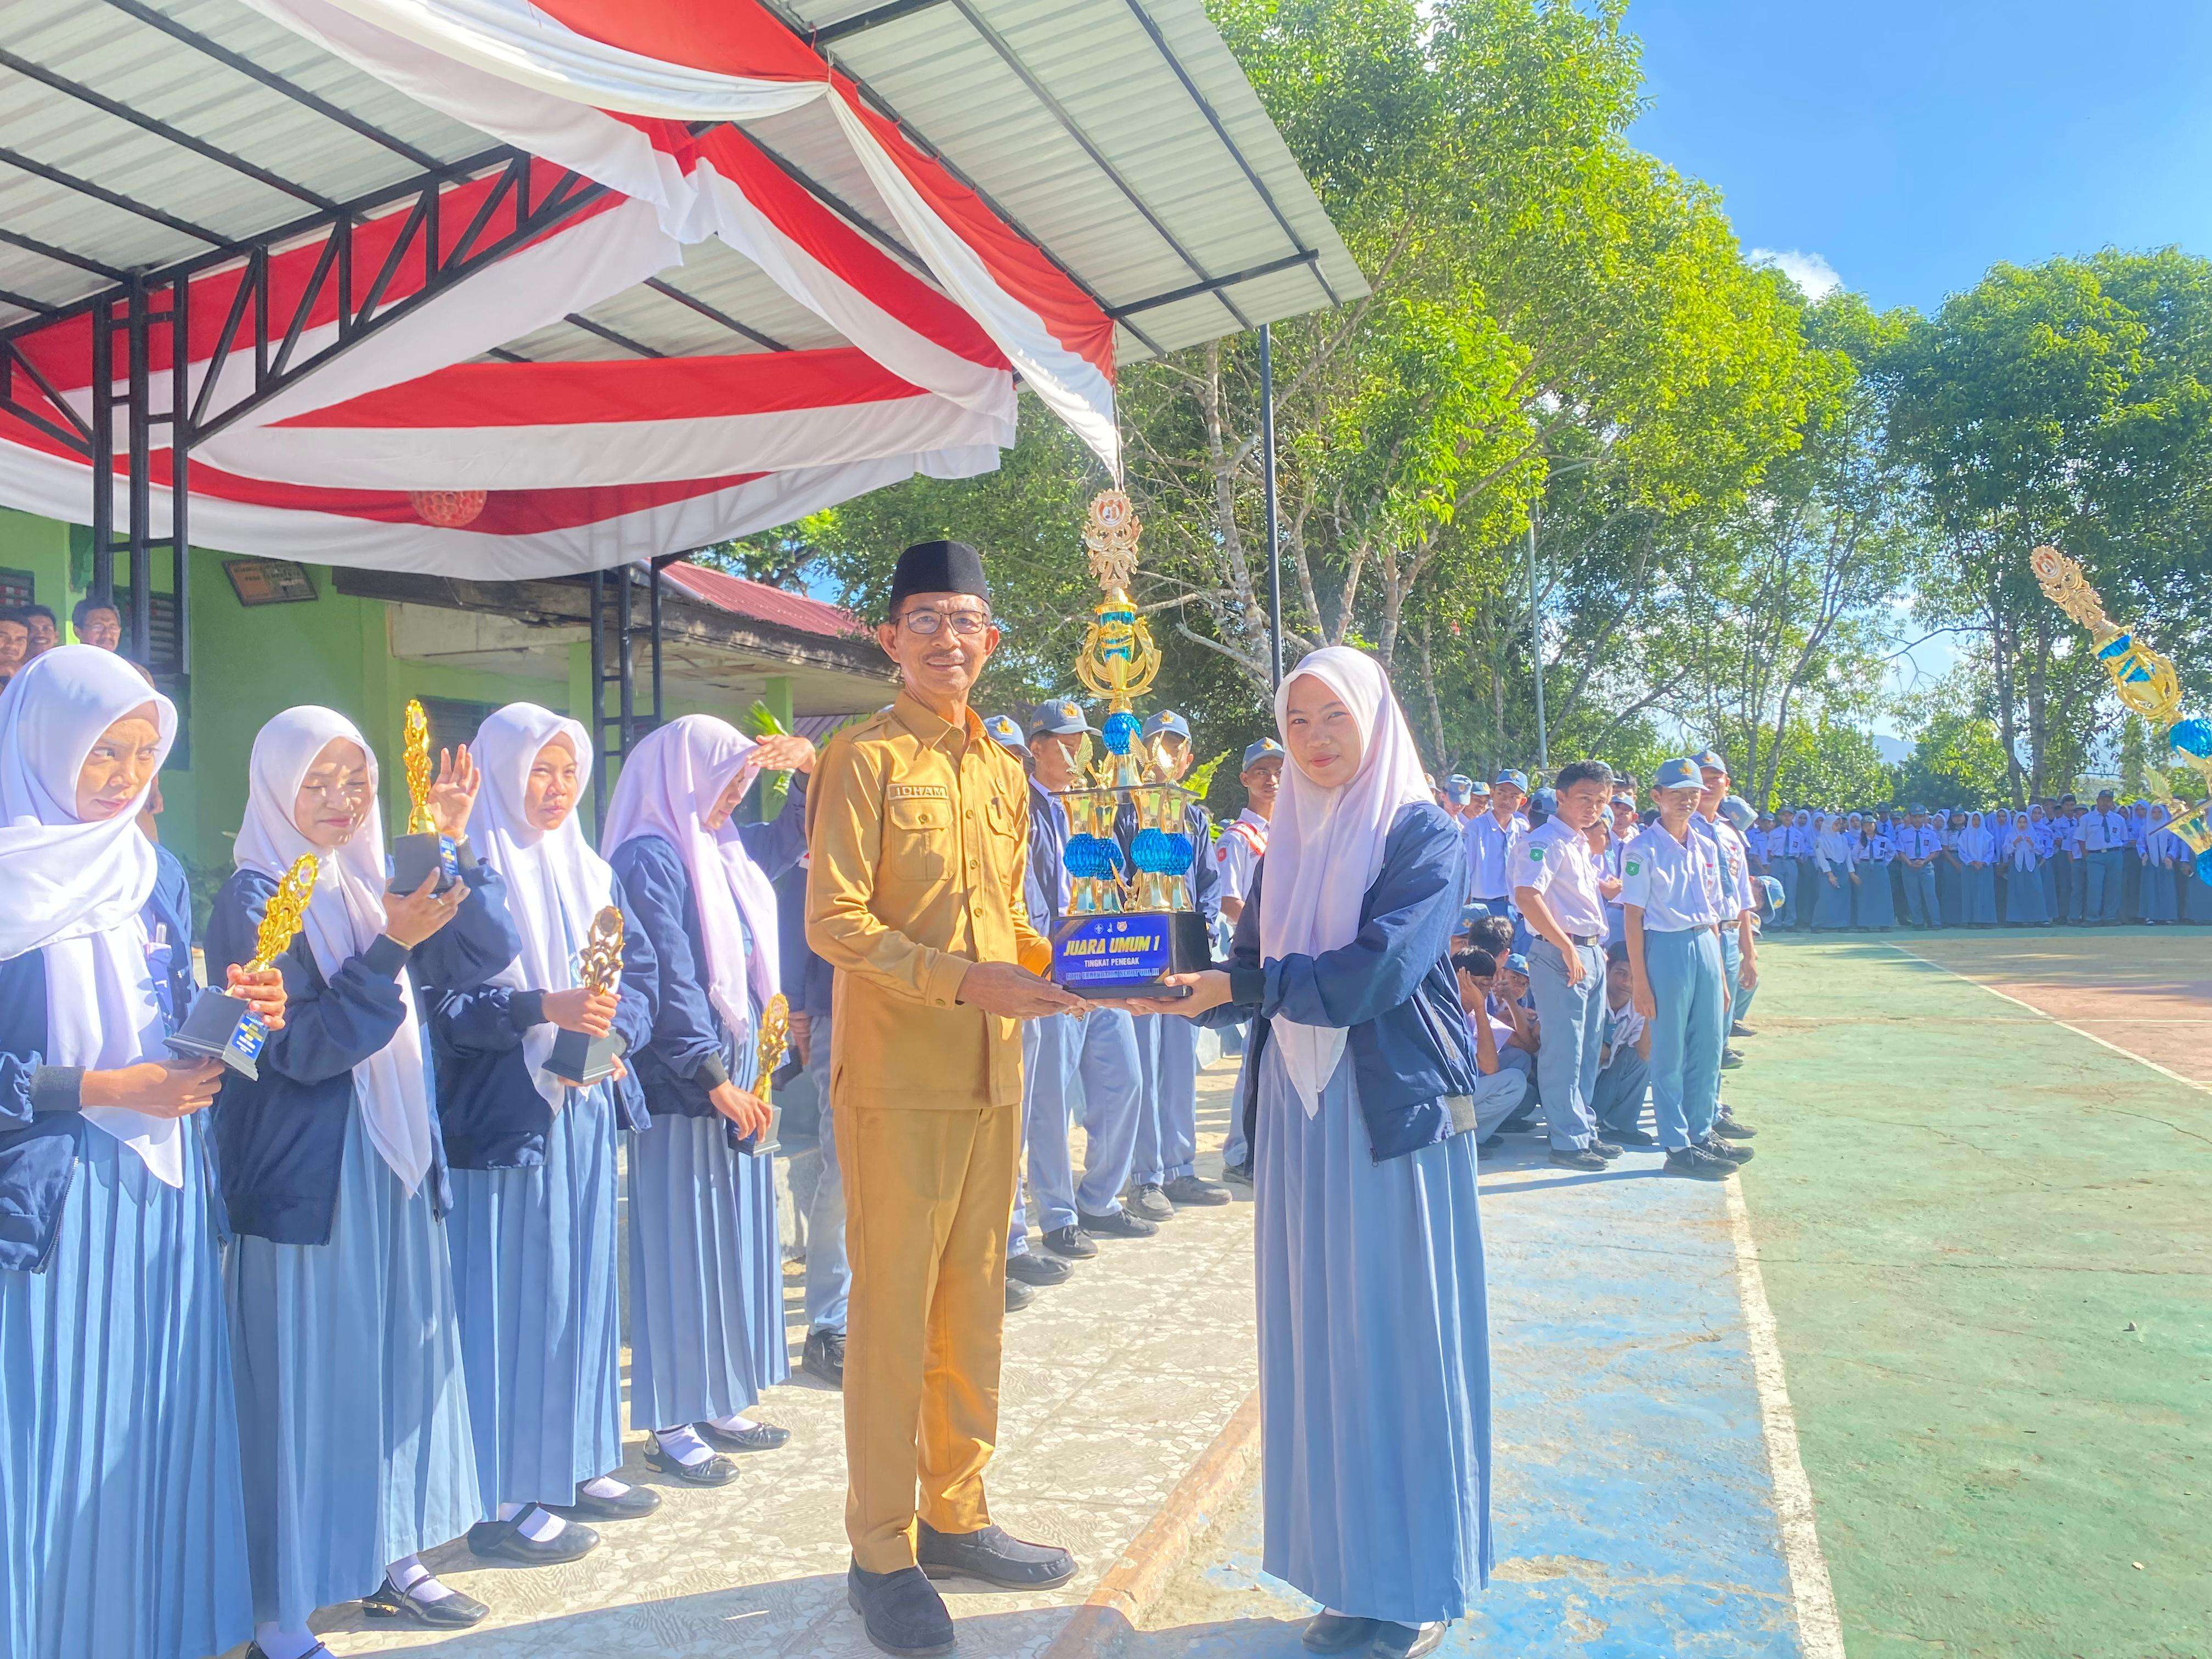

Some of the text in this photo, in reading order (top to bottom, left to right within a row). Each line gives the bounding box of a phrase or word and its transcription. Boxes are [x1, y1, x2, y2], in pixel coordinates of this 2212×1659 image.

[896, 786, 947, 796] IDHAM
[1063, 935, 1160, 956] JUARA UMUM 1
[1084, 957, 1139, 968] TINGKAT PENEGAK
